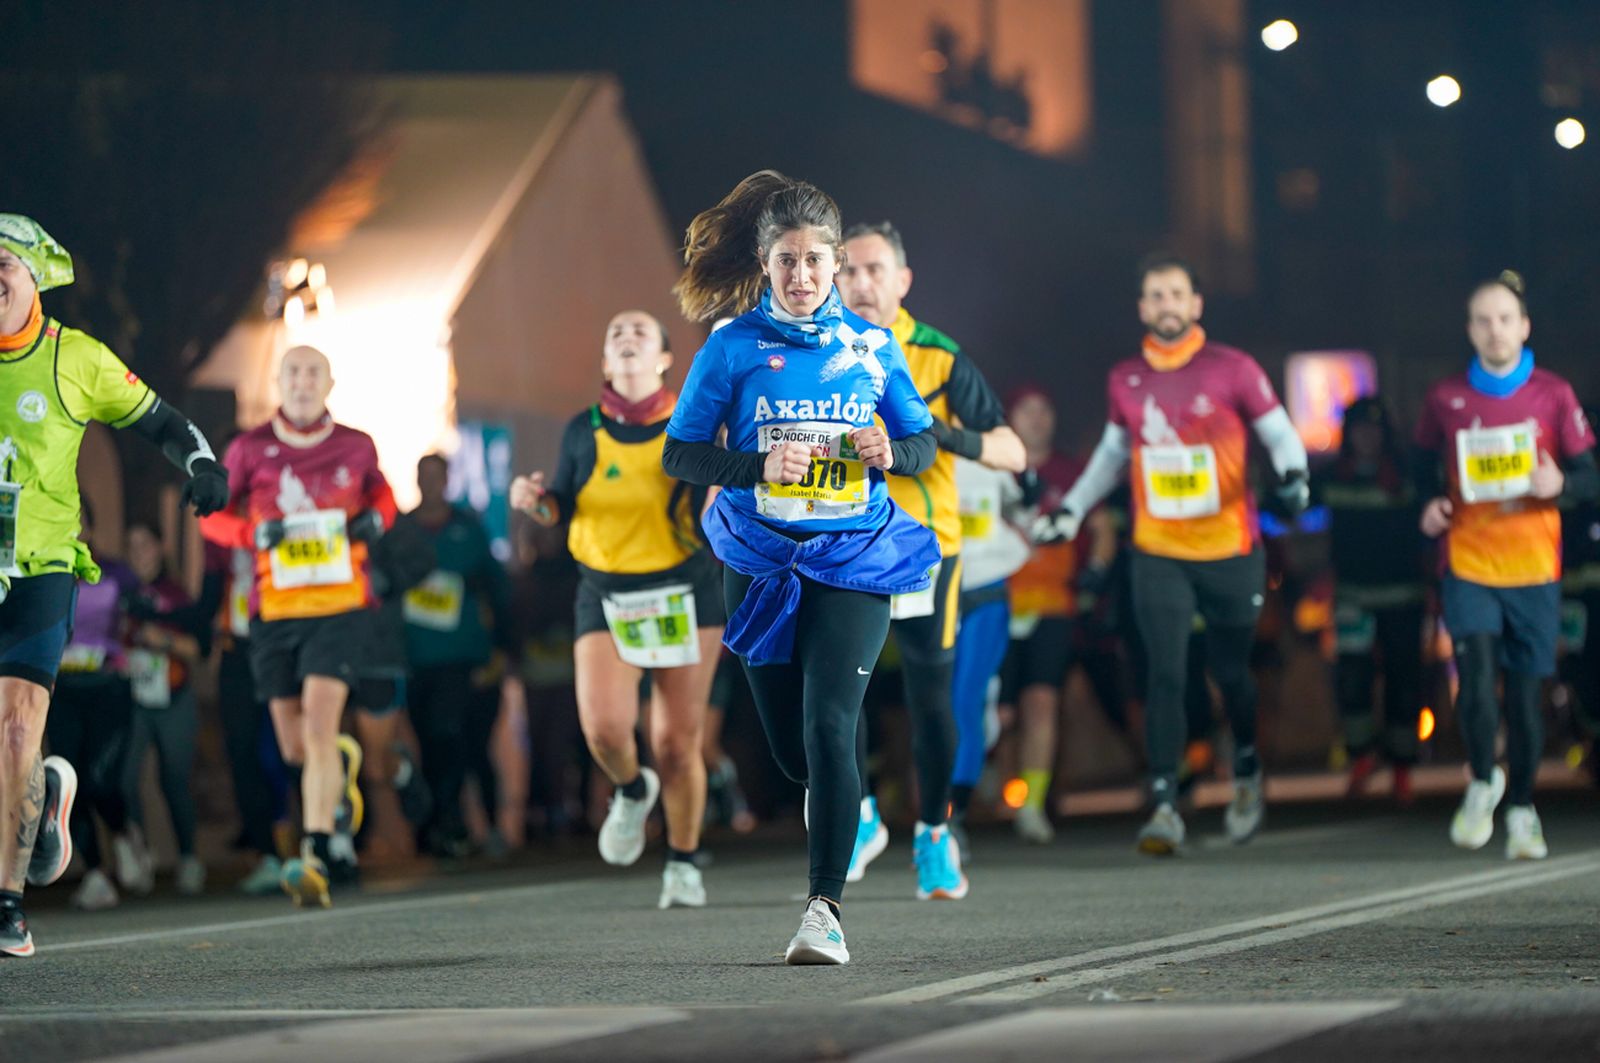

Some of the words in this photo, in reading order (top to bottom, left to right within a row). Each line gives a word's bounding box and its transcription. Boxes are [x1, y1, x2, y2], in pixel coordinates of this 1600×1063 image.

[754, 392, 871, 423] Axarlón
[783, 431, 816, 442] NOCHE
[818, 433, 831, 444] DE
